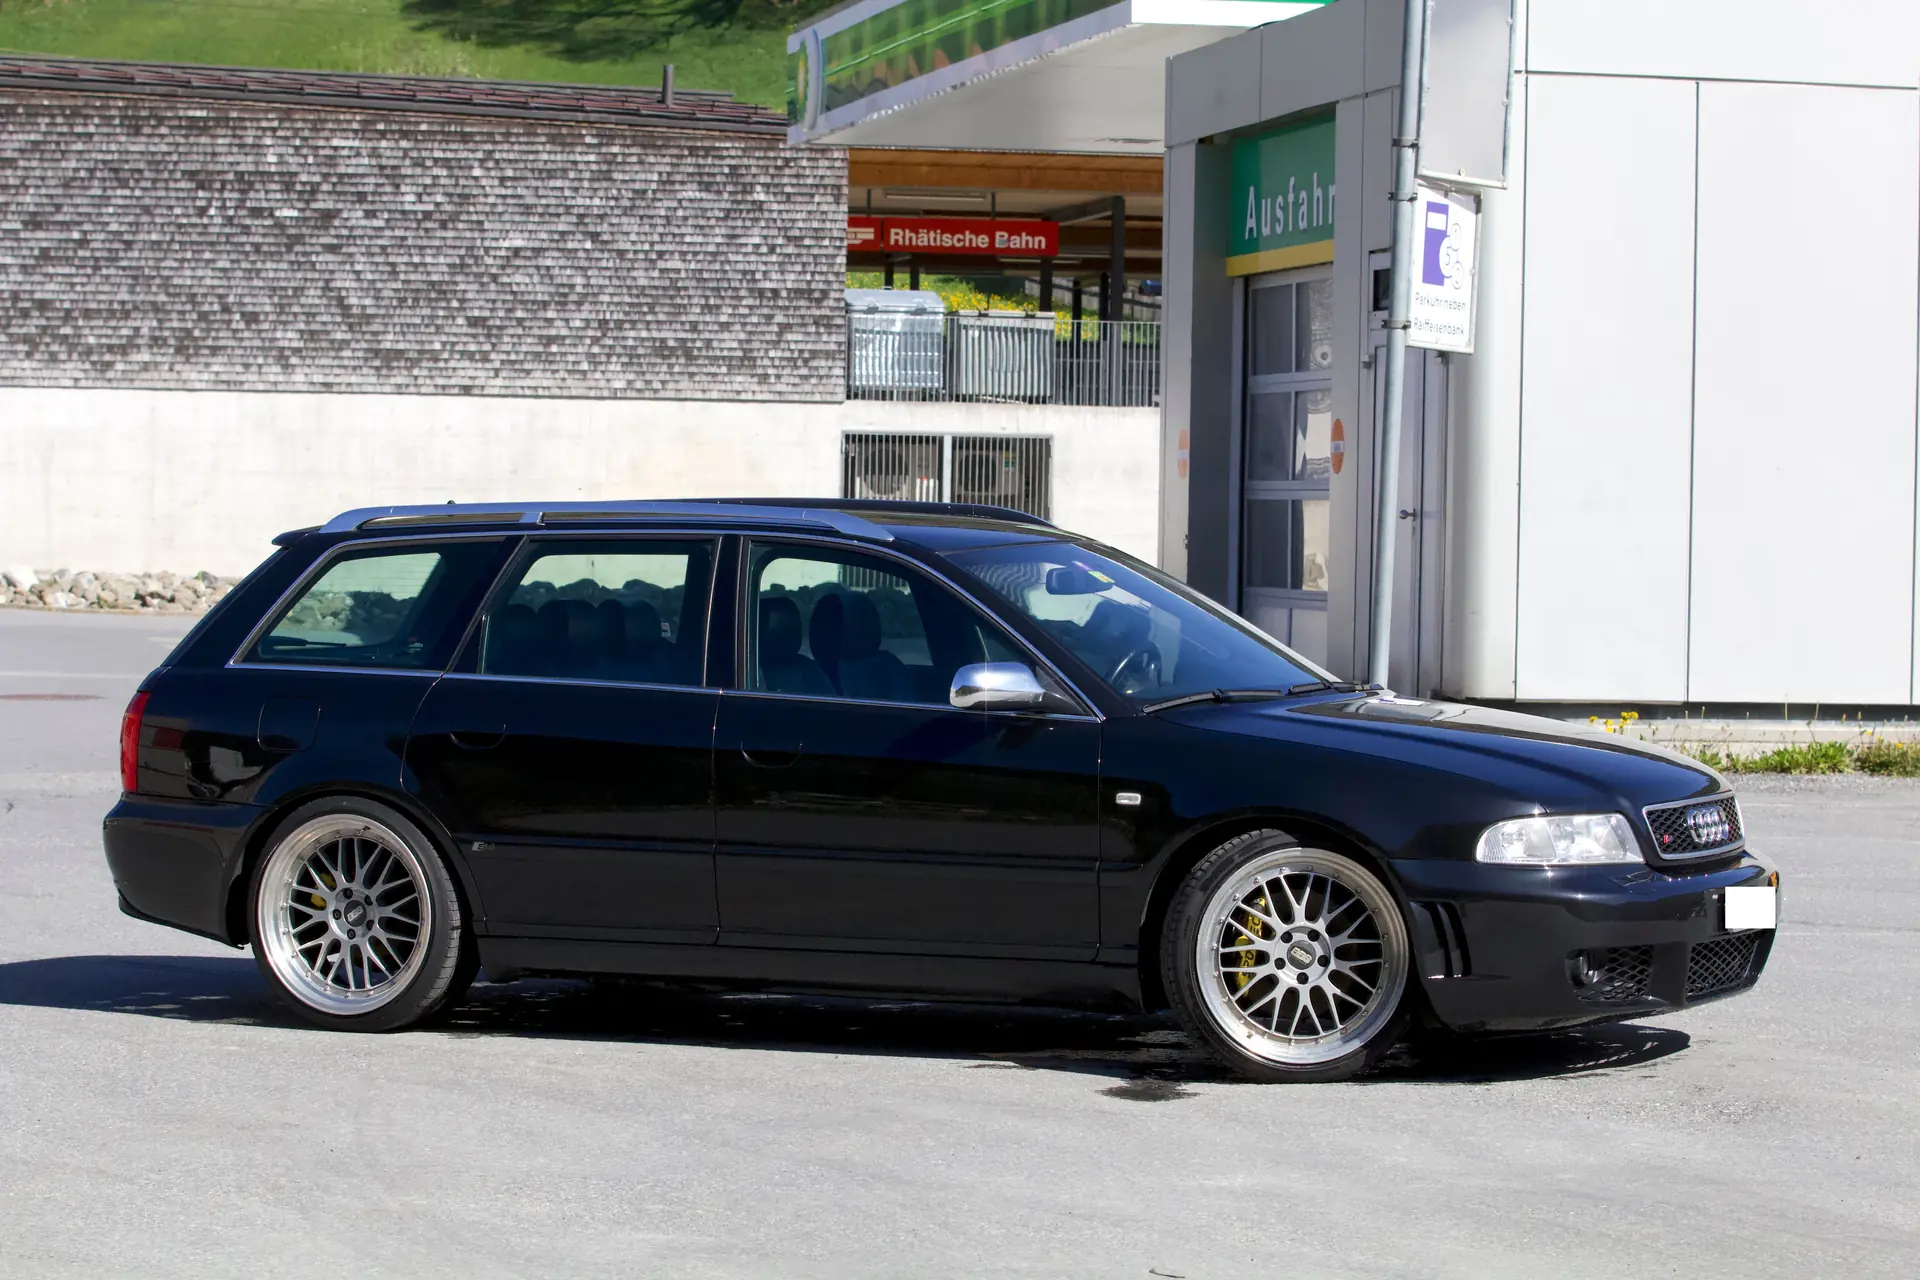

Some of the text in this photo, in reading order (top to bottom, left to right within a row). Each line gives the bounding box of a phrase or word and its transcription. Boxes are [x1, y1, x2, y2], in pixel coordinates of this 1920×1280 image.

[1245, 172, 1335, 240] Ausfahr
[889, 228, 1046, 249] Rhätische Bahn
[1415, 292, 1466, 311] Parkuhr neben
[1413, 317, 1465, 336] Raiffeisenbank
[1290, 946, 1313, 964] BBS
